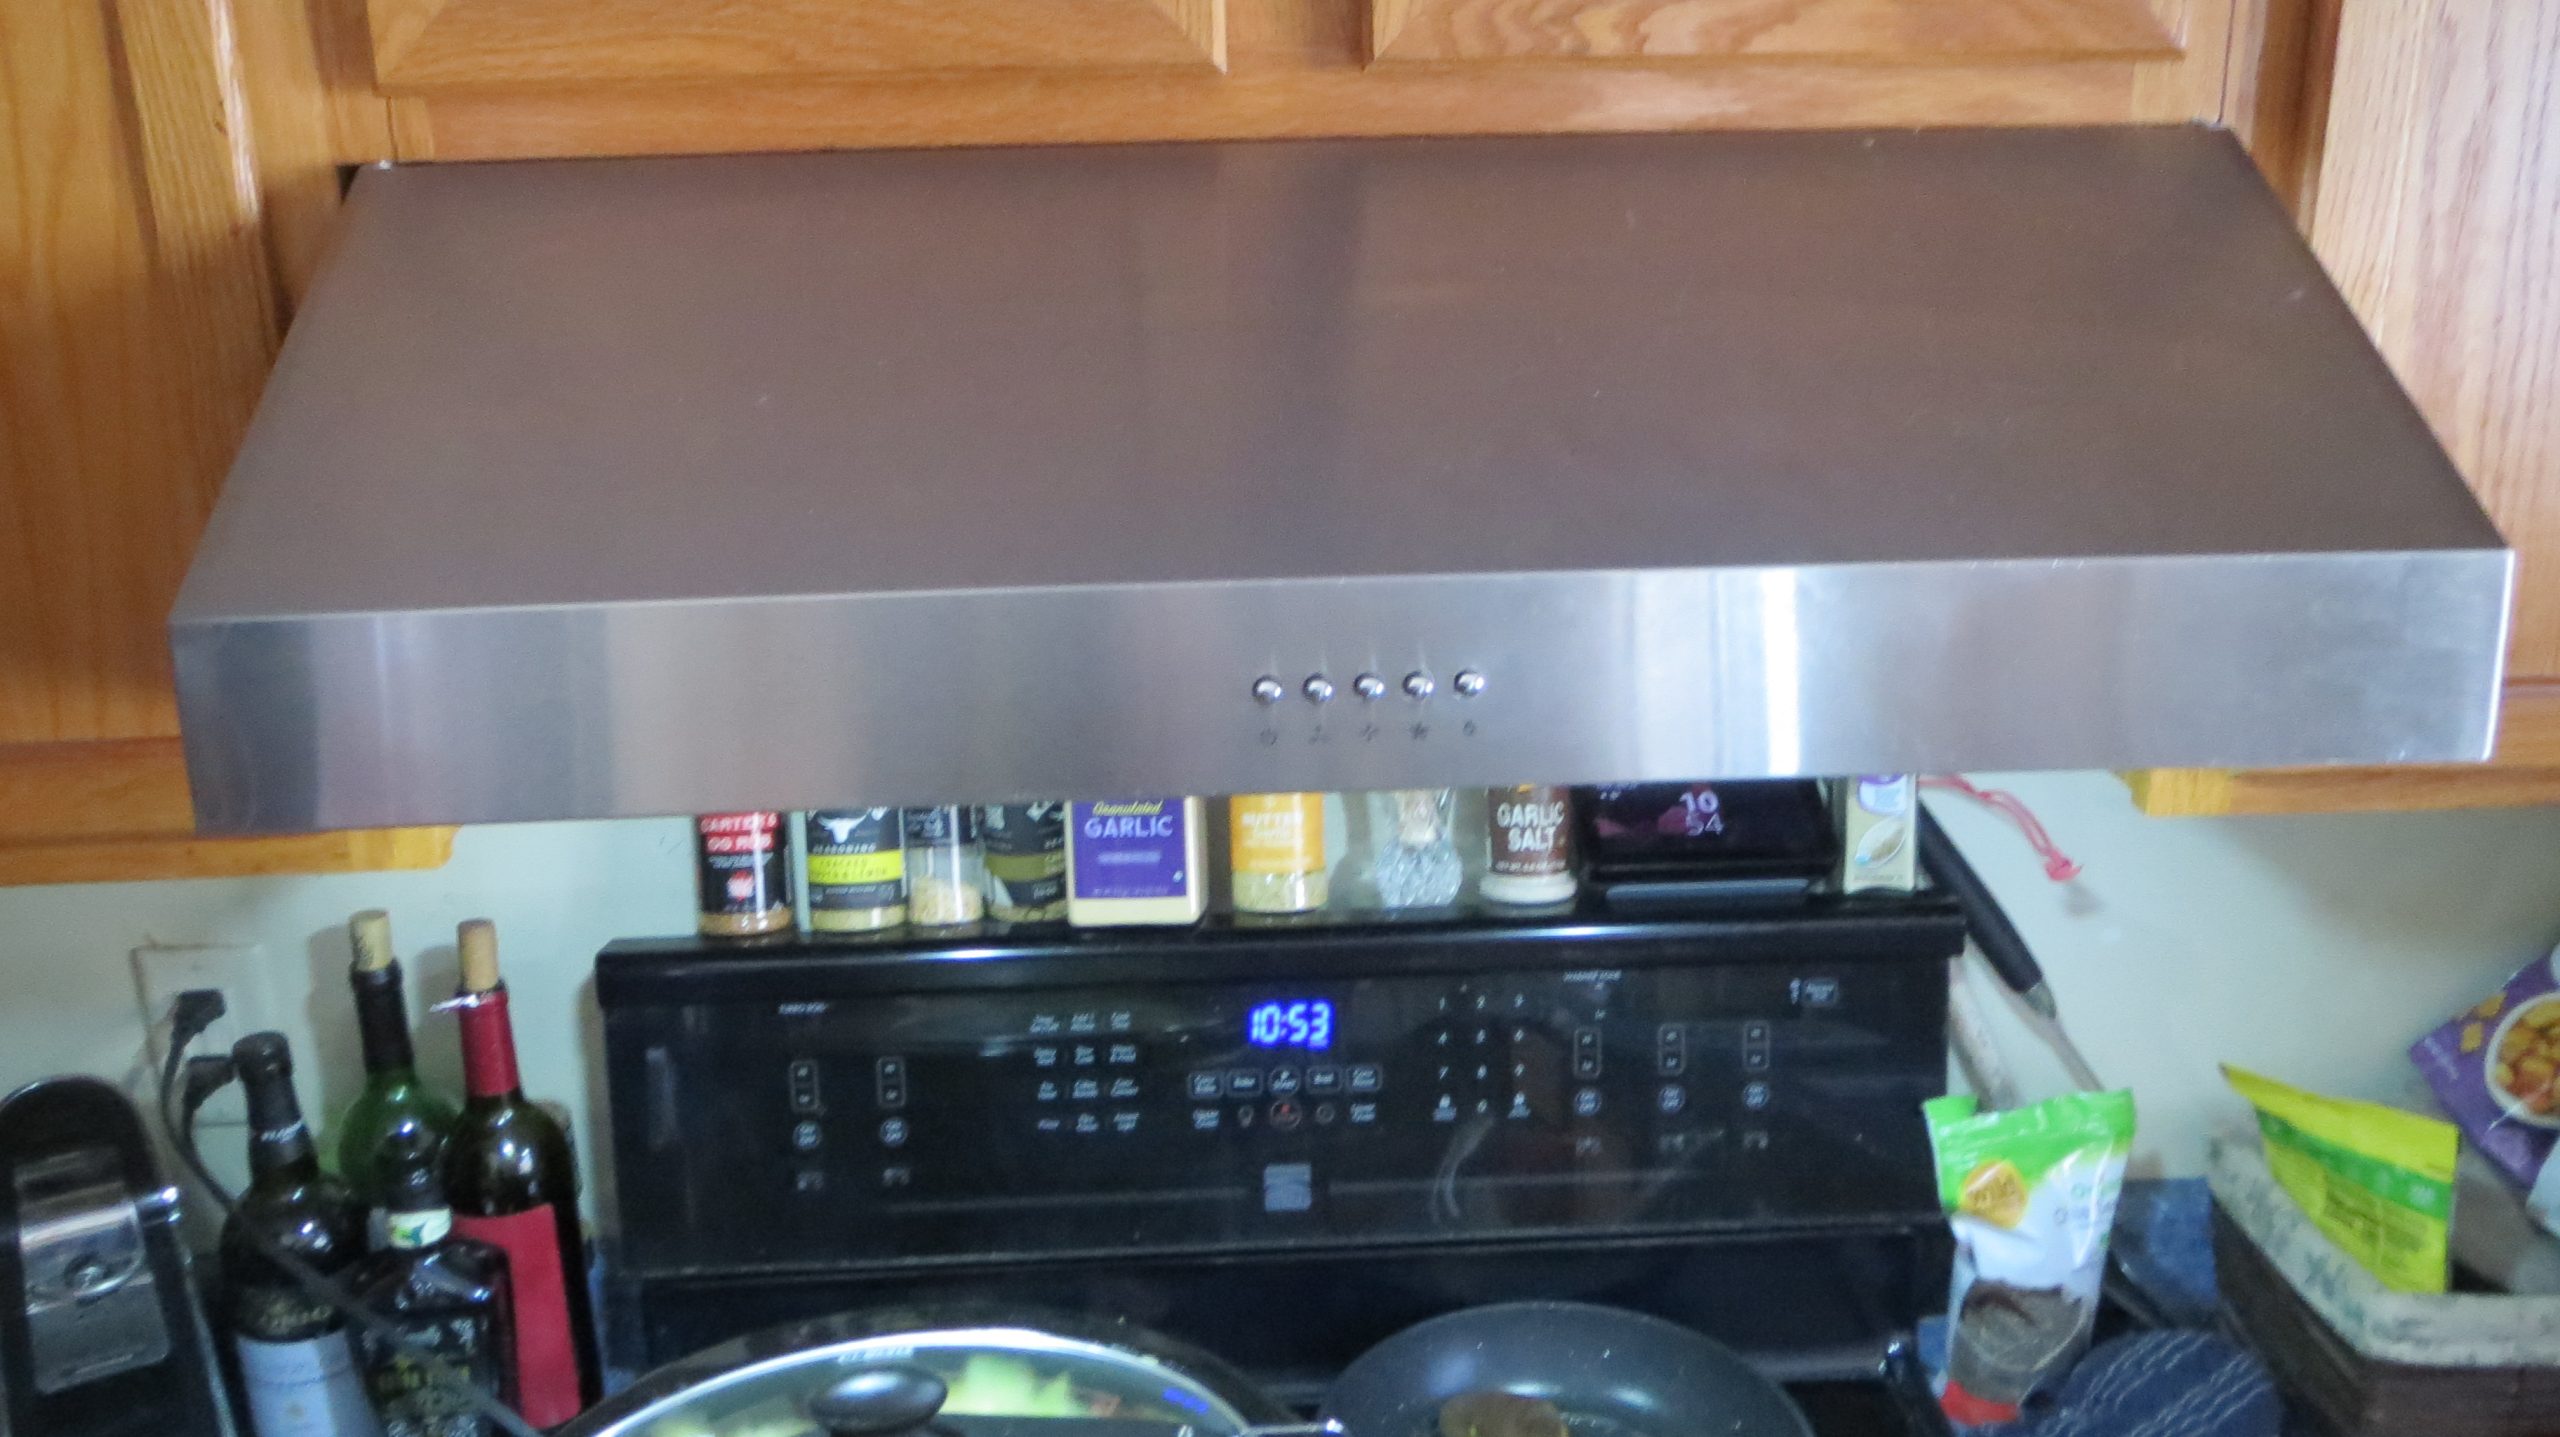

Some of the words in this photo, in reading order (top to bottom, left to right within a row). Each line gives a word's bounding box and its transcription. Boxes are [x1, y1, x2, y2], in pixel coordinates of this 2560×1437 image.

[1497, 801, 1565, 828] GARLIC
[1680, 790, 1719, 814] 10
[1084, 815, 1174, 838] GARLIC
[1686, 812, 1725, 836] 54
[1508, 826, 1557, 852] SALT
[1250, 1002, 1330, 1044] 10:53
